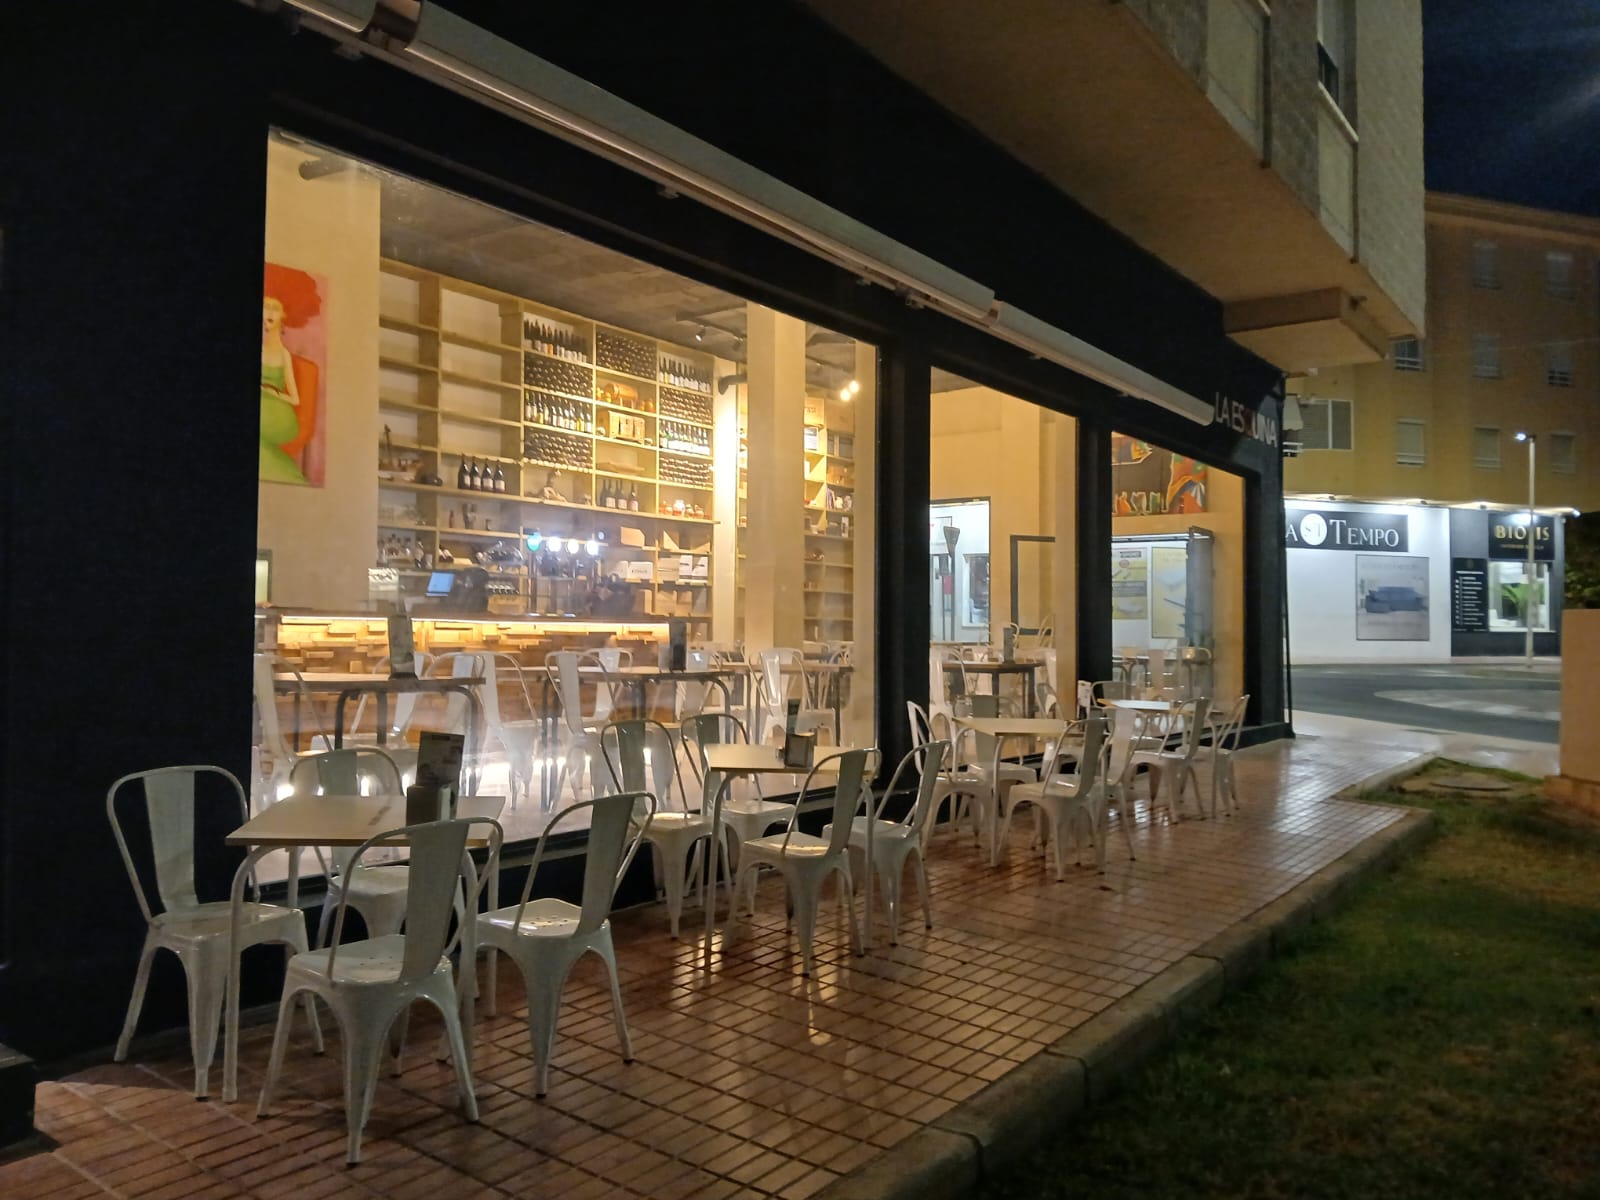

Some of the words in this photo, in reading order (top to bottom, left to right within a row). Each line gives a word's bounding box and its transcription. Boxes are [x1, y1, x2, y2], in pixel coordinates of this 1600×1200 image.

[1215, 392, 1231, 427] LA
[1231, 400, 1278, 448] ESUINA
[1329, 519, 1400, 547] TEMPO
[1494, 525, 1550, 541] BIOIS
